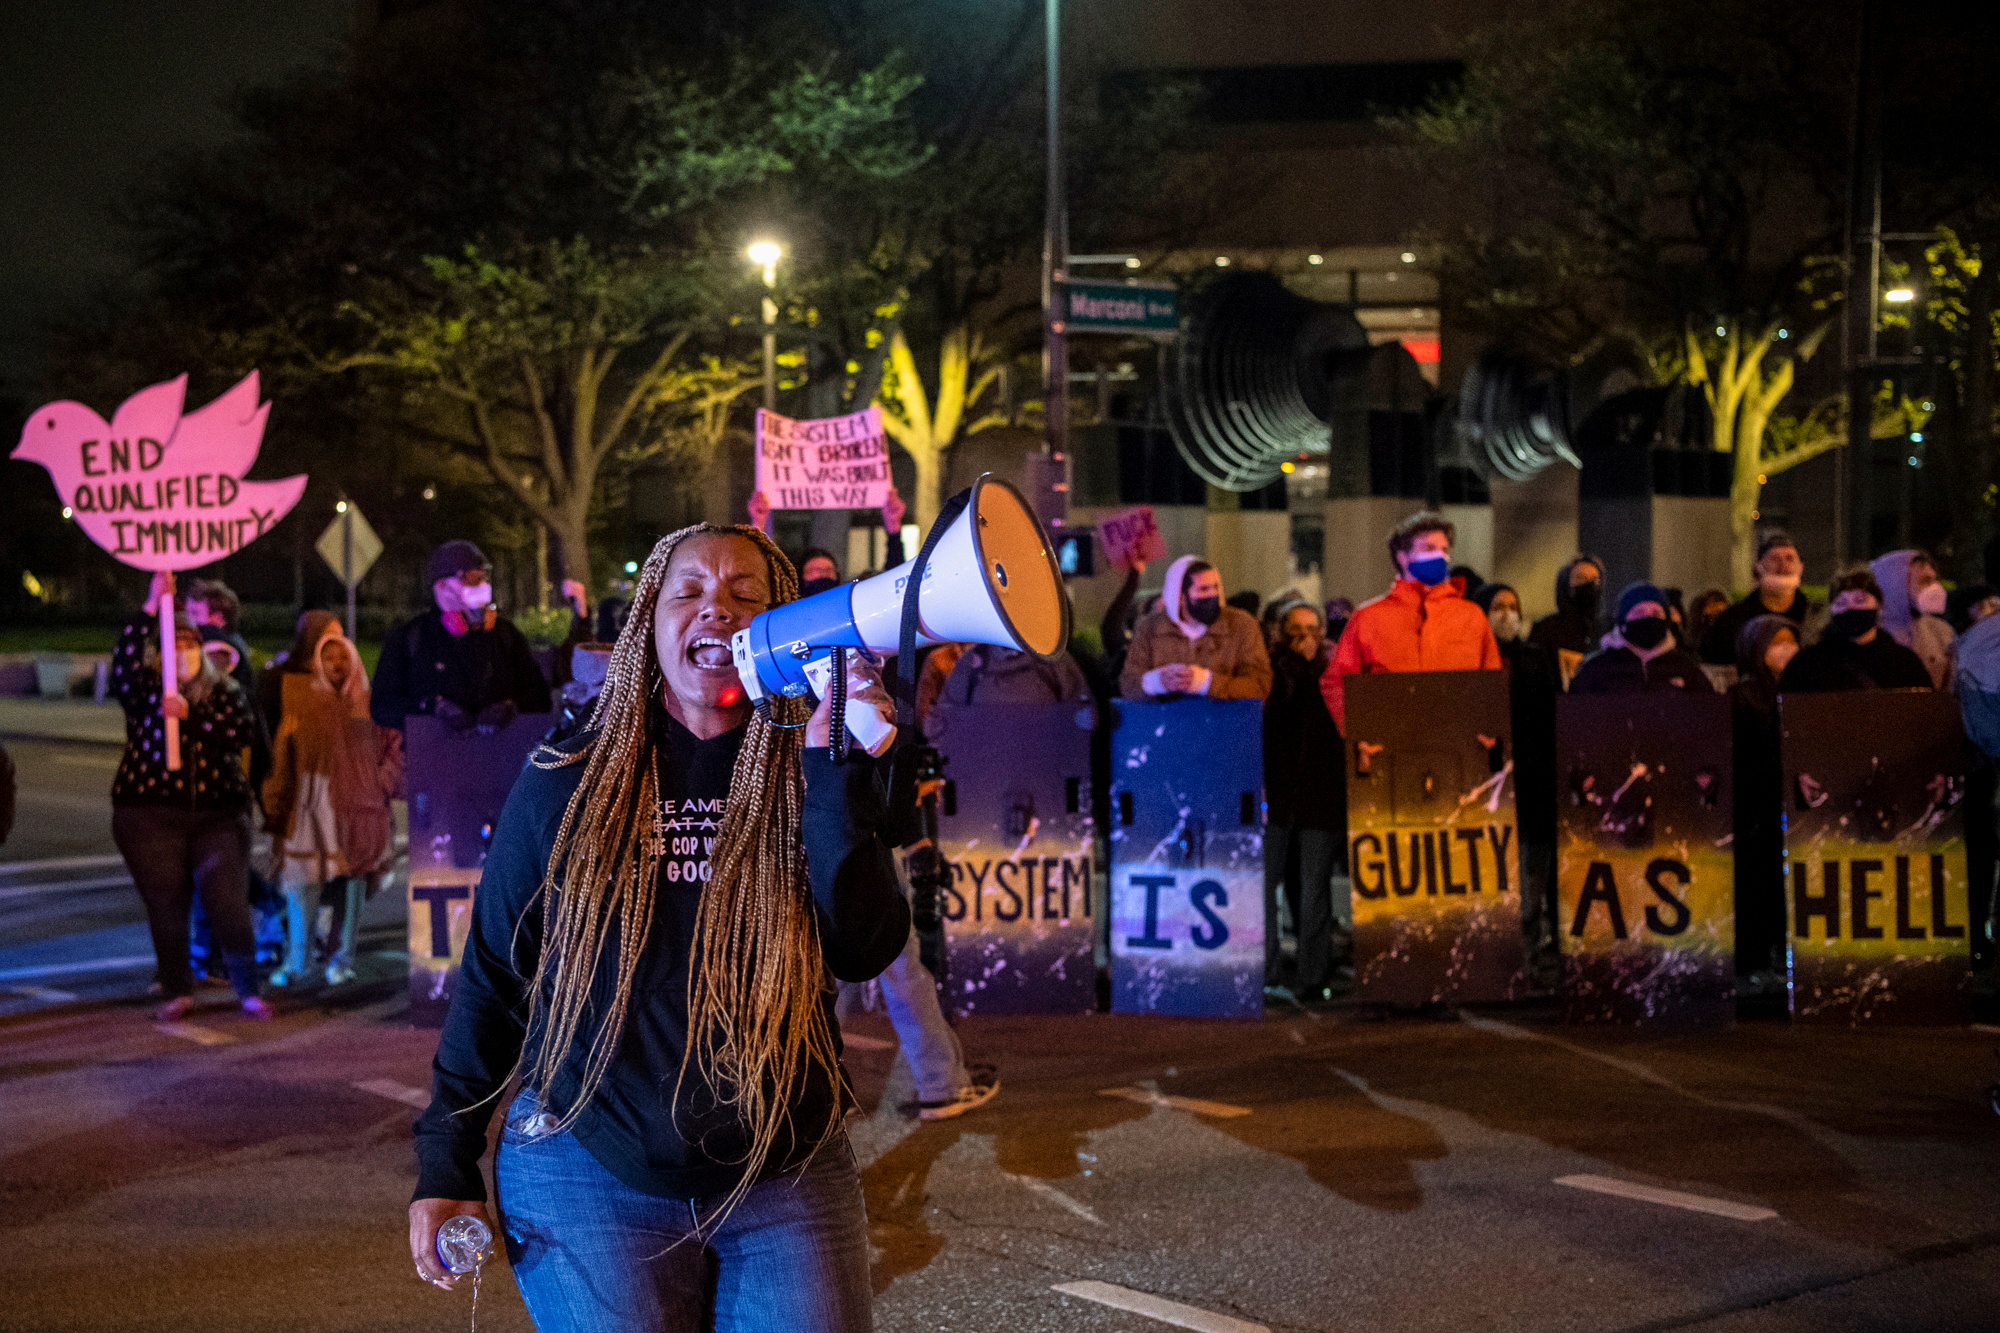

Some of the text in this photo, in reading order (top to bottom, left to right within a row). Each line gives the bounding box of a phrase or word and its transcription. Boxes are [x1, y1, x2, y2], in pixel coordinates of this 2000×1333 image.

[1070, 292, 1146, 319] Marconi
[81, 437, 164, 476] END
[773, 463, 793, 483] IT
[804, 466, 845, 484] WAS
[74, 473, 241, 513] QUALIFIED
[775, 487, 869, 509] THIS WAY
[895, 562, 932, 594] PE
[681, 798, 726, 814] AME
[672, 836, 698, 856] COP
[1352, 825, 1512, 900] GUILTY
[667, 860, 713, 882] GOO
[943, 857, 1091, 922] SYSTEM
[1126, 874, 1230, 951] IS
[1570, 858, 1691, 939] AS
[1793, 855, 1965, 939] HELL
[412, 885, 470, 958] T
